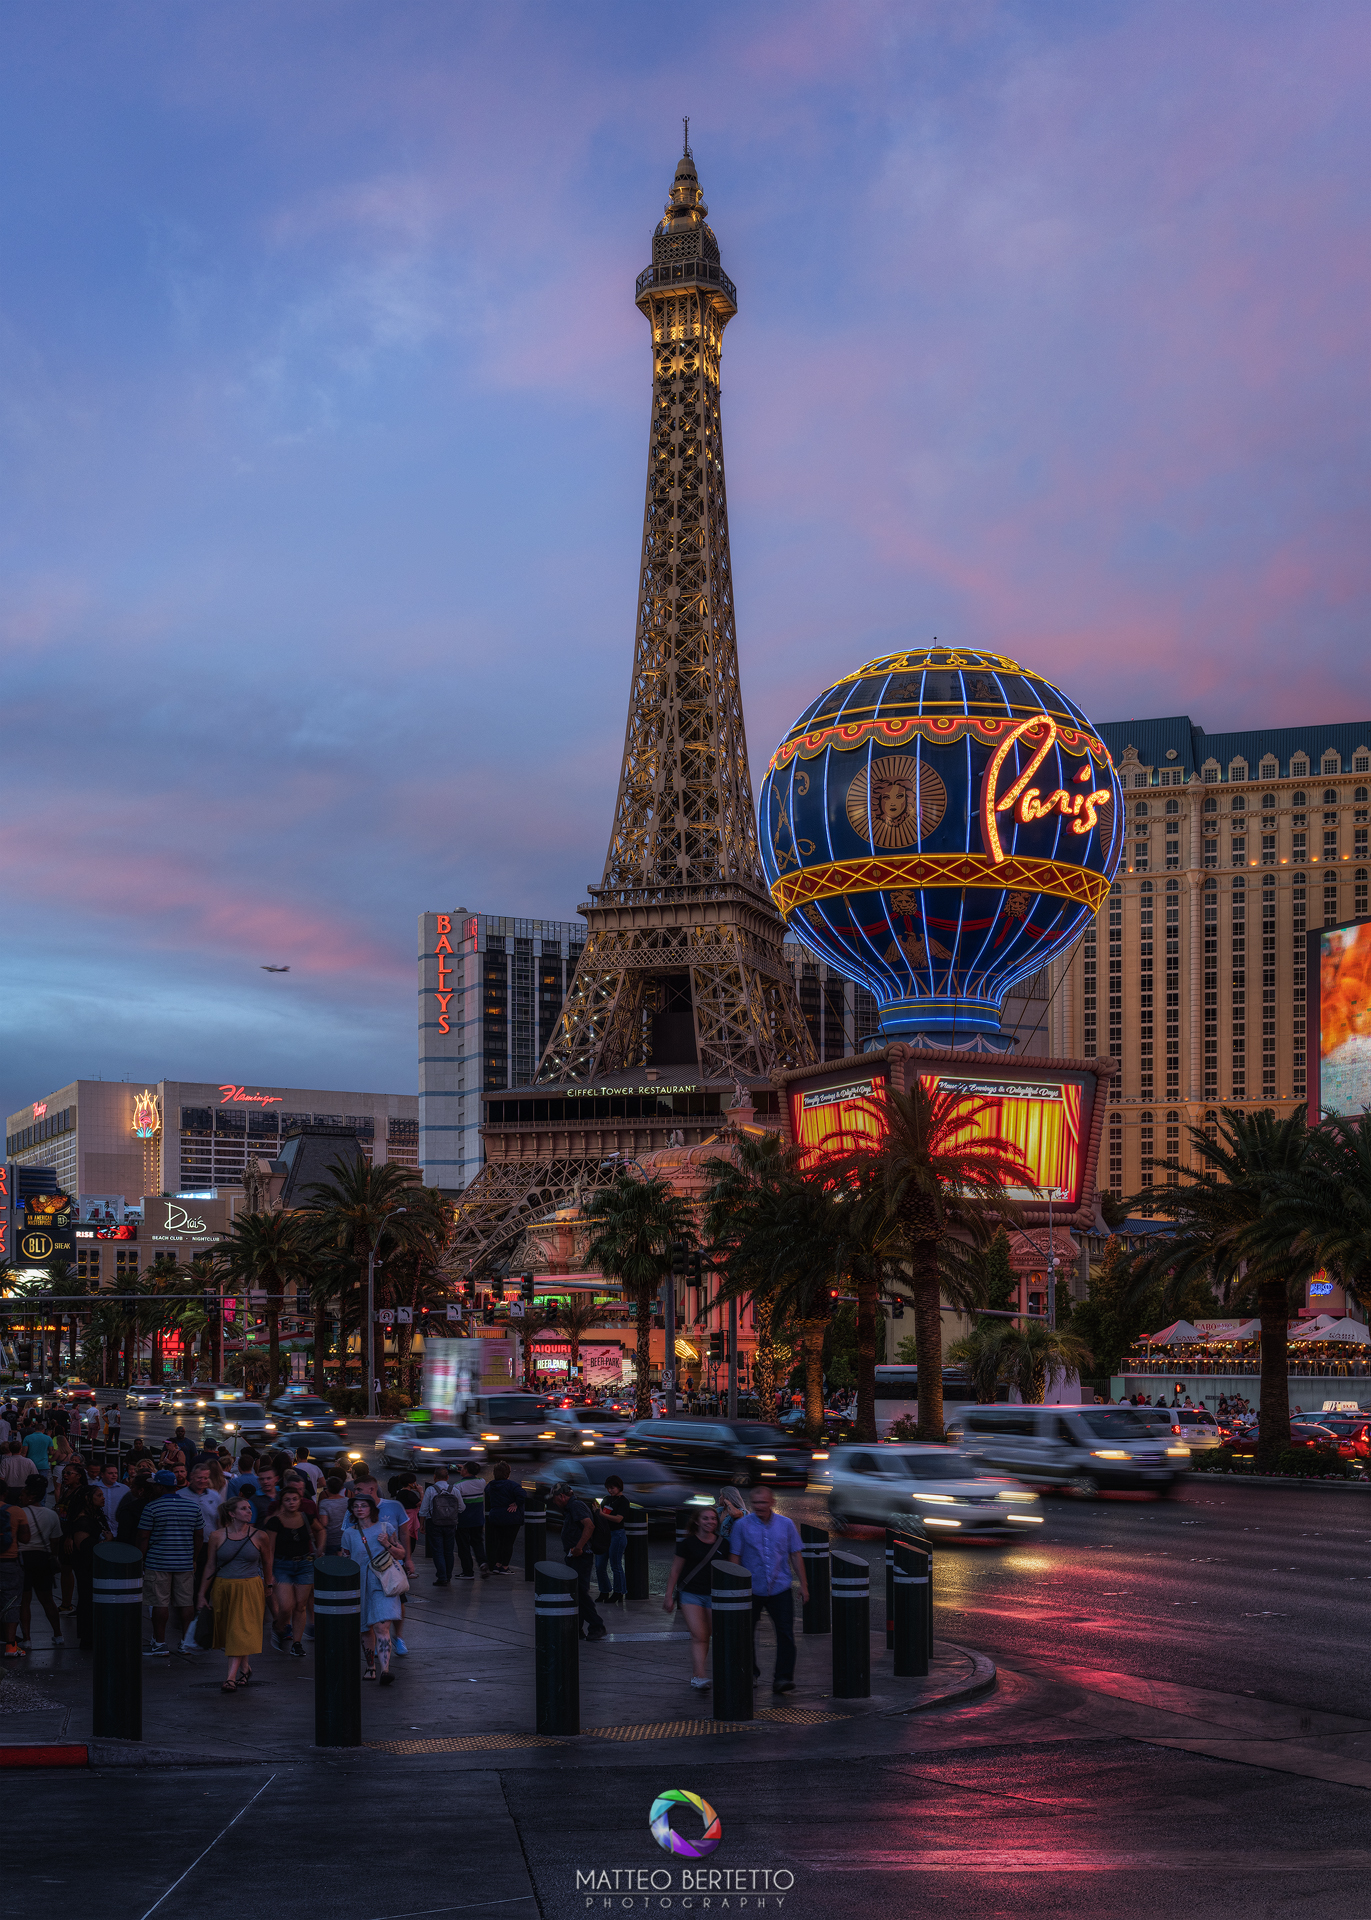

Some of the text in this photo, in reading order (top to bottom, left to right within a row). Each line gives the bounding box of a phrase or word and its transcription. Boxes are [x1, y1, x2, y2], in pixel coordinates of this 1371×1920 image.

[981, 714, 1111, 864] Paris
[434, 914, 454, 1034] BALLYS
[218, 1084, 283, 1107] Flamingo
[566, 1085, 697, 1098] EIFFEL TOWER RESTAURANT
[1038, 1088, 1059, 1099] Days
[163, 1201, 207, 1234] Drai's
[28, 1237, 46, 1253] BLT
[1195, 1323, 1217, 1331] CABO
